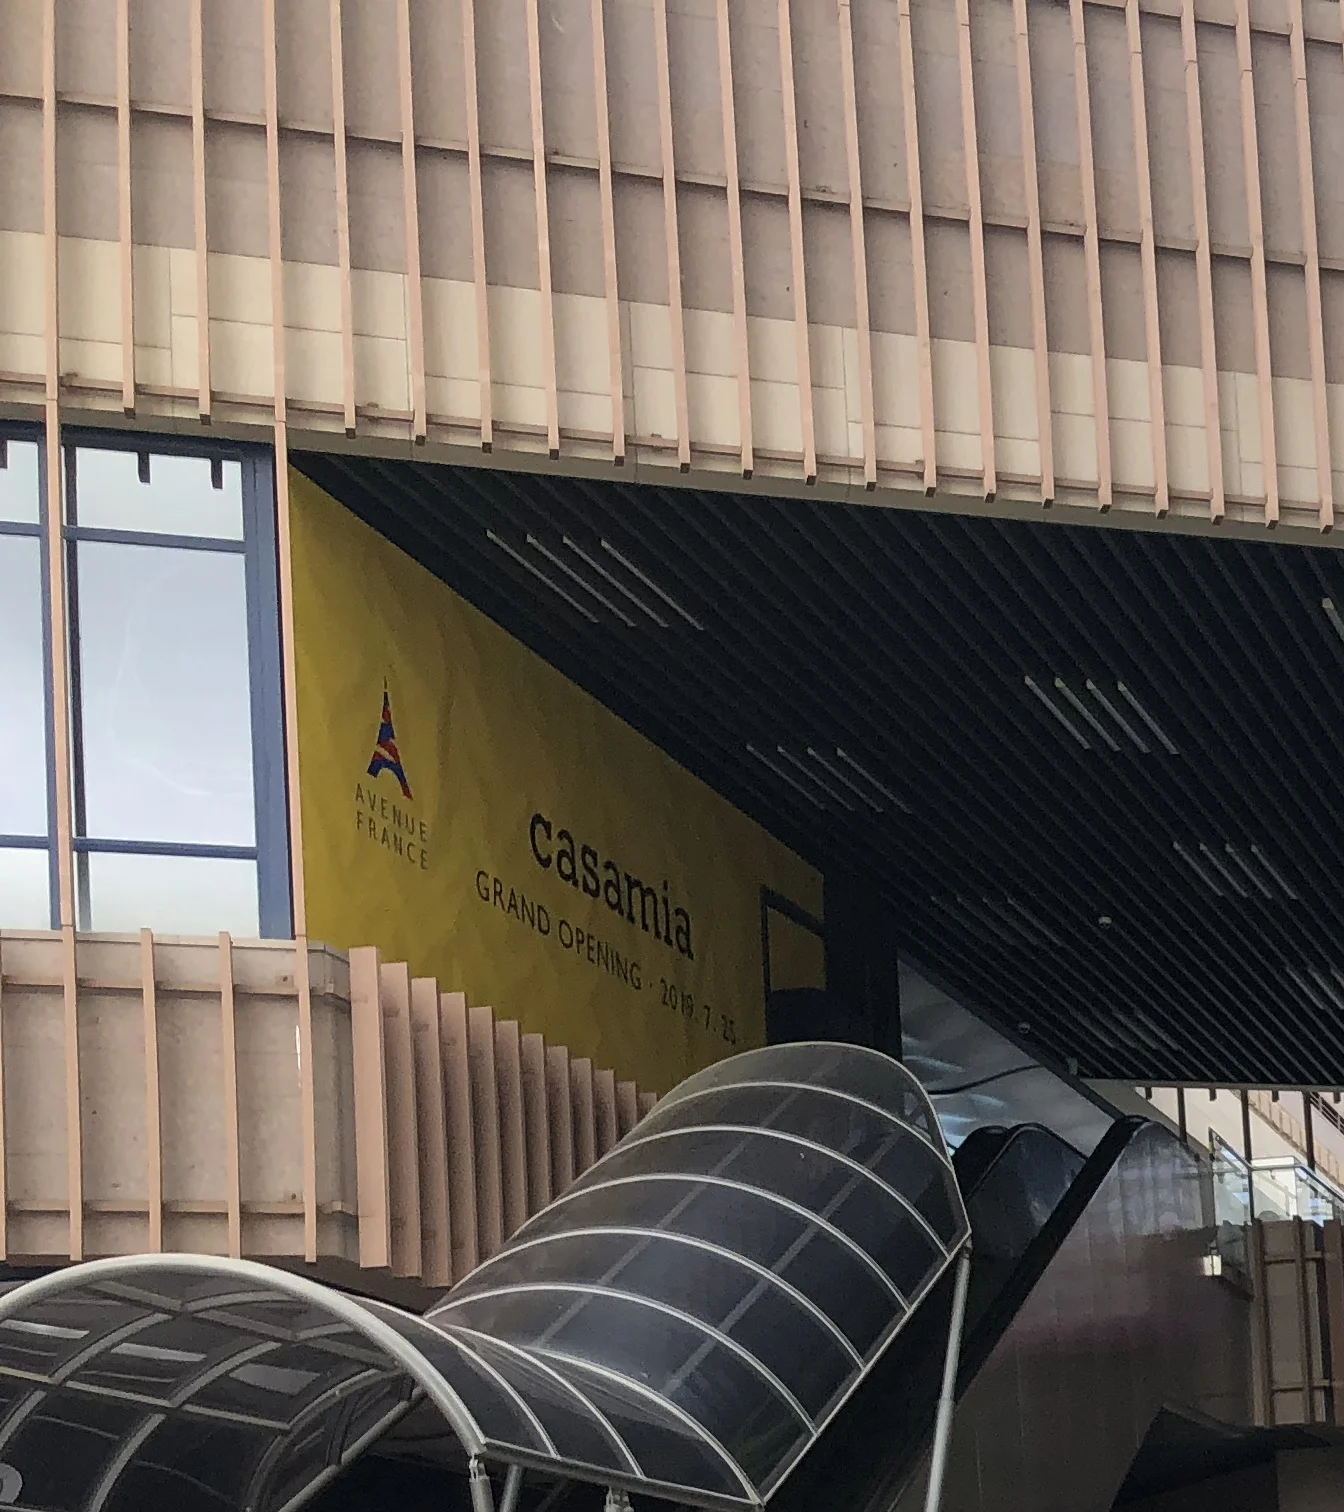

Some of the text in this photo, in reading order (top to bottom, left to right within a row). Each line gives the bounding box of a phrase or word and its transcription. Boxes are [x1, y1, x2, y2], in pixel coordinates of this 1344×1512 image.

[355, 782, 428, 843] AVENUE
[356, 810, 429, 870] FRANCE
[476, 869, 551, 936] GRAND
[558, 919, 643, 992] OPENING
[529, 813, 694, 960] casamia
